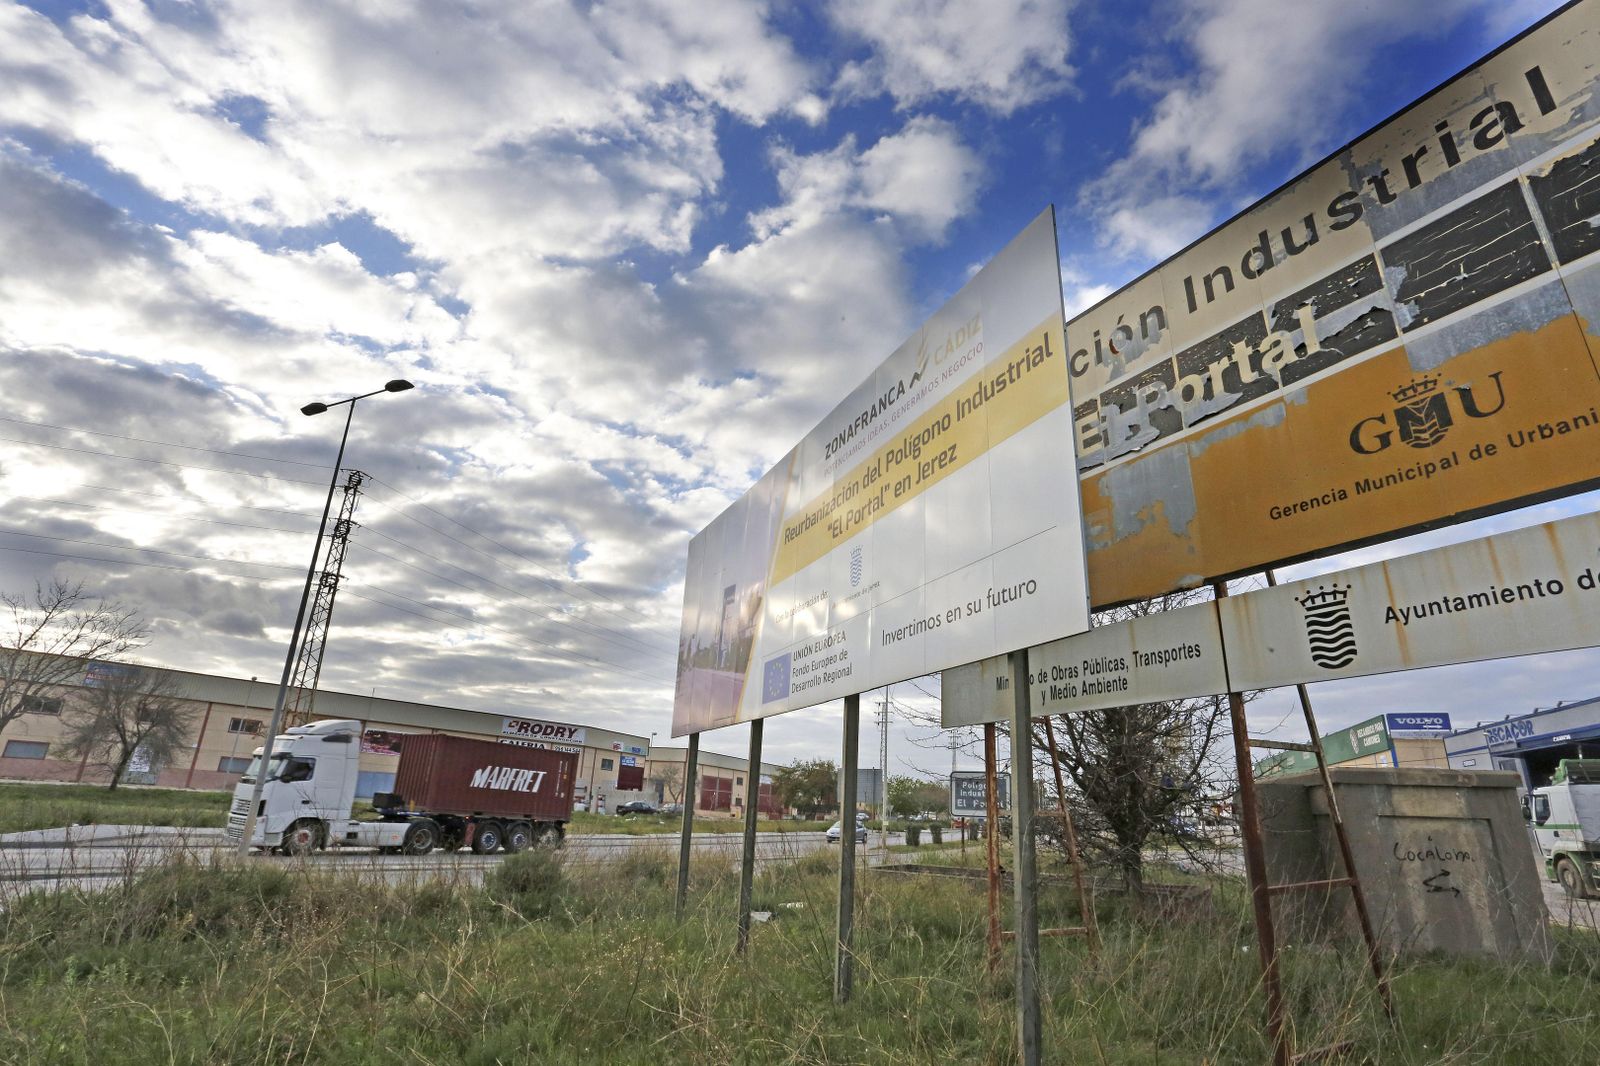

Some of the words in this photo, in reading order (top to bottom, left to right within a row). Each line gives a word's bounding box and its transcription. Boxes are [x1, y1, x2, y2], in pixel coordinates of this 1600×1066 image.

[1183, 65, 1558, 315] Industrial
[891, 377, 939, 423] GENERAMOS
[941, 341, 984, 382] NEGOCIO
[784, 481, 860, 545] Reurbanización
[862, 457, 882, 489] del
[886, 413, 951, 473] Polígono
[956, 331, 1054, 423] Industrial
[825, 380, 906, 460] ZONAFRANCA
[894, 474, 912, 498] en
[915, 443, 958, 485] Jerez
[1269, 487, 1348, 521] Gerencia
[1354, 450, 1460, 496] Municipal
[1468, 442, 1498, 462] de
[1506, 407, 1600, 449] Urbani
[882, 613, 942, 647] Invertimos
[946, 606, 961, 624] en
[966, 598, 982, 617] su
[986, 578, 1037, 609] futuro
[1384, 578, 1564, 626] Ayuntamiento
[1577, 568, 1600, 590] d
[792, 666, 810, 678] Fondo
[811, 655, 838, 672] Europeo
[839, 648, 848, 662] de
[793, 643, 813, 662] UNIÓN
[814, 630, 847, 654] EUROPEA
[1037, 668, 1048, 684] de
[1051, 663, 1079, 682] Obras
[1082, 656, 1129, 677] Públicas,
[1132, 641, 1201, 669] Transportes
[791, 675, 822, 694] Desarrollo
[823, 662, 853, 685] Regional
[1041, 690, 1046, 706] y
[1050, 682, 1078, 702] Medio
[1081, 676, 1129, 697] Ambiente
[517, 720, 578, 739] RODRY
[1394, 717, 1443, 725] VOLVO
[469, 765, 548, 793] MARFRET
